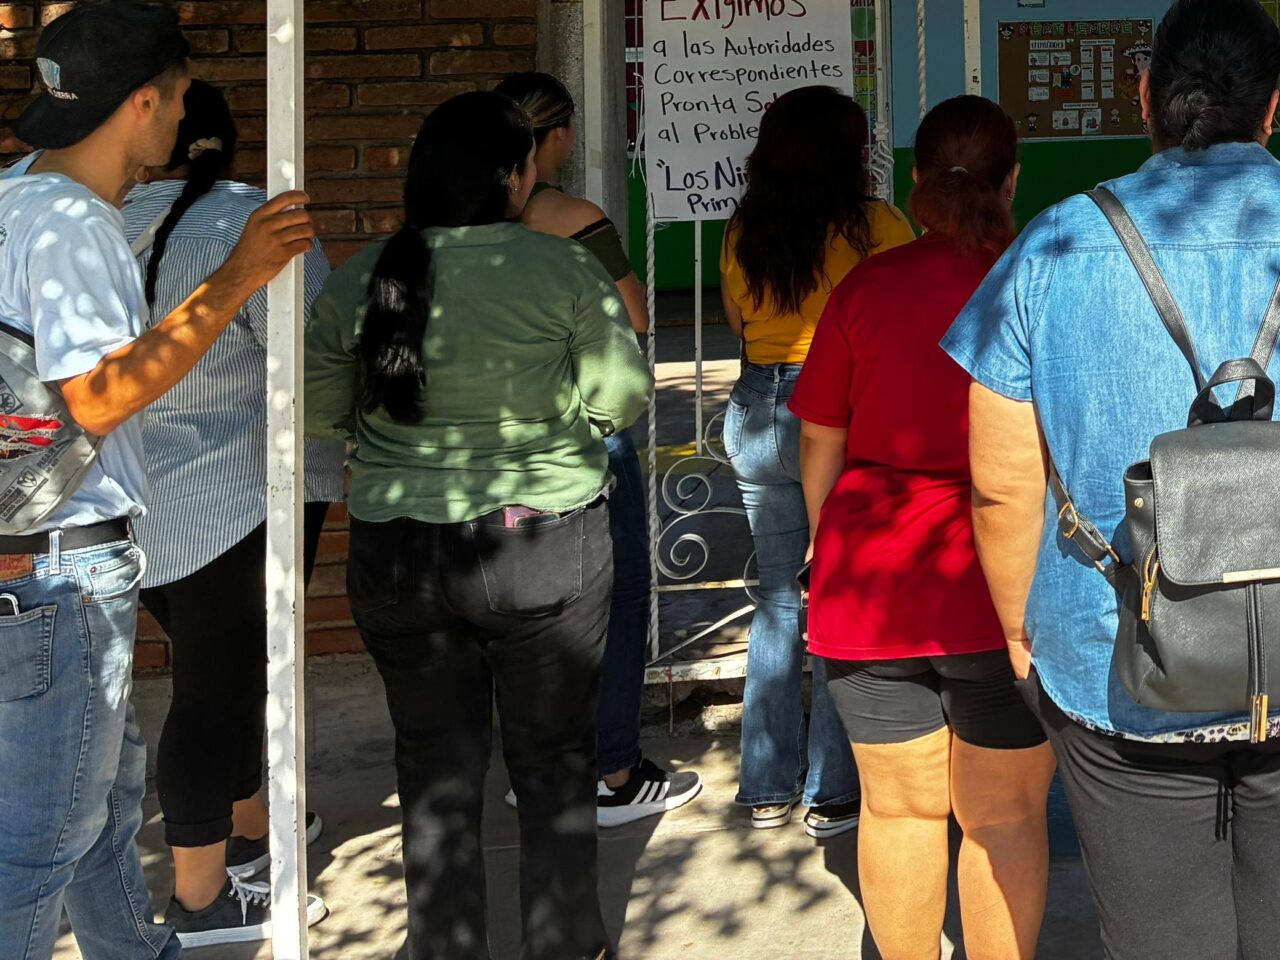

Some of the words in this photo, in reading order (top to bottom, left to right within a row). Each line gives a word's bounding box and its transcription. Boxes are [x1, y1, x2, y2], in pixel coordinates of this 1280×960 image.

[653, 40, 666, 57] a
[683, 30, 715, 58] las
[724, 31, 835, 57] Autoridades
[654, 59, 844, 86] Correspondientes
[661, 91, 737, 115] Pronta
[658, 122, 680, 143] al
[694, 122, 759, 144] Proble
